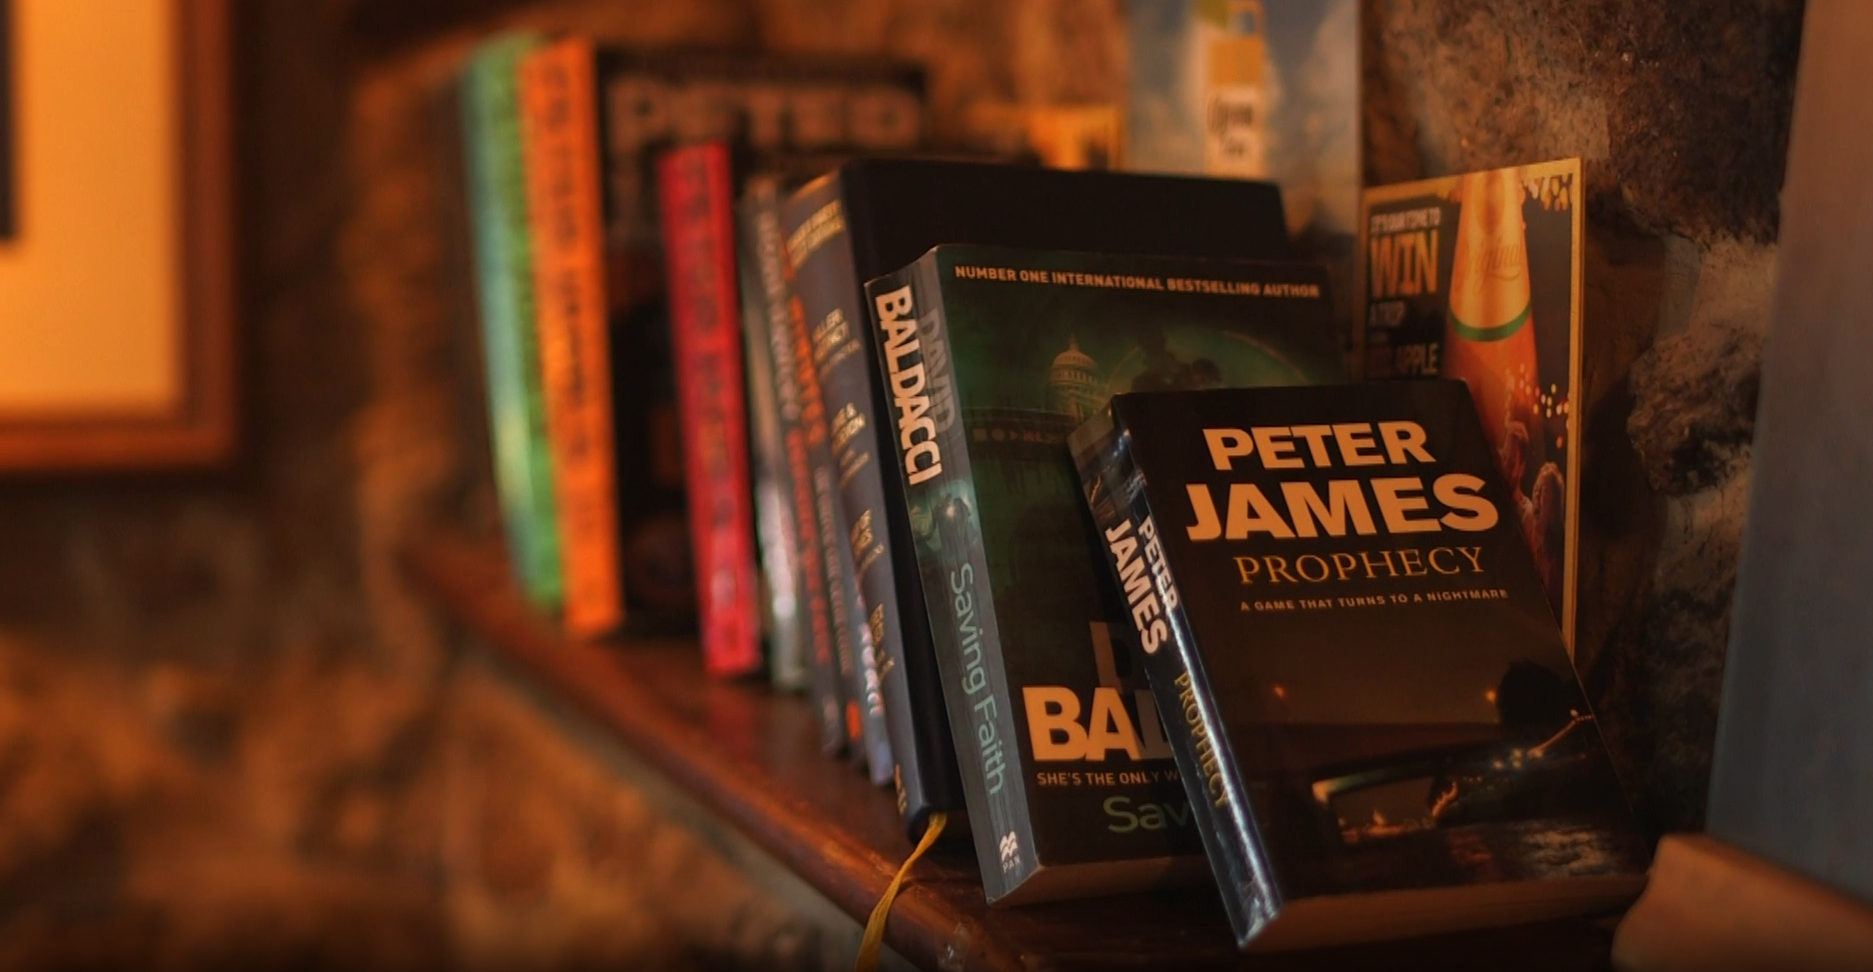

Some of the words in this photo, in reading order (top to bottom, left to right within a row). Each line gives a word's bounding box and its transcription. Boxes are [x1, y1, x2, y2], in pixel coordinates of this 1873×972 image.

[954, 265, 1017, 281] NUMBER
[1019, 270, 1049, 283] ONE
[1052, 272, 1165, 291] INTERNATIONAL
[1166, 277, 1261, 297] BESTSELLING
[1263, 283, 1320, 298] AUTHOR
[1371, 229, 1438, 298] WIN
[875, 285, 943, 486] BALDACCI
[1202, 420, 1437, 471] PETER
[1185, 473, 1499, 541] JAMES
[1104, 518, 1169, 655] JAMES
[1137, 513, 1179, 612] PETER
[1232, 546, 1485, 585] PROPHECY
[1240, 601, 1250, 611] A
[1253, 599, 1296, 612] GAME
[1299, 598, 1334, 610] THAT
[1338, 595, 1386, 608] TURNS
[1390, 593, 1409, 604] TO
[1413, 592, 1423, 602] A
[1426, 588, 1509, 602] NIGHTMARE
[951, 562, 987, 695] Saving
[974, 695, 1007, 796] Faith
[1173, 667, 1229, 809] PROPHECY
[1036, 771, 1082, 787] SHE'S
[1085, 771, 1117, 786] THE
[1119, 771, 1160, 785] ONLY
[1002, 854, 1021, 874] PAN
